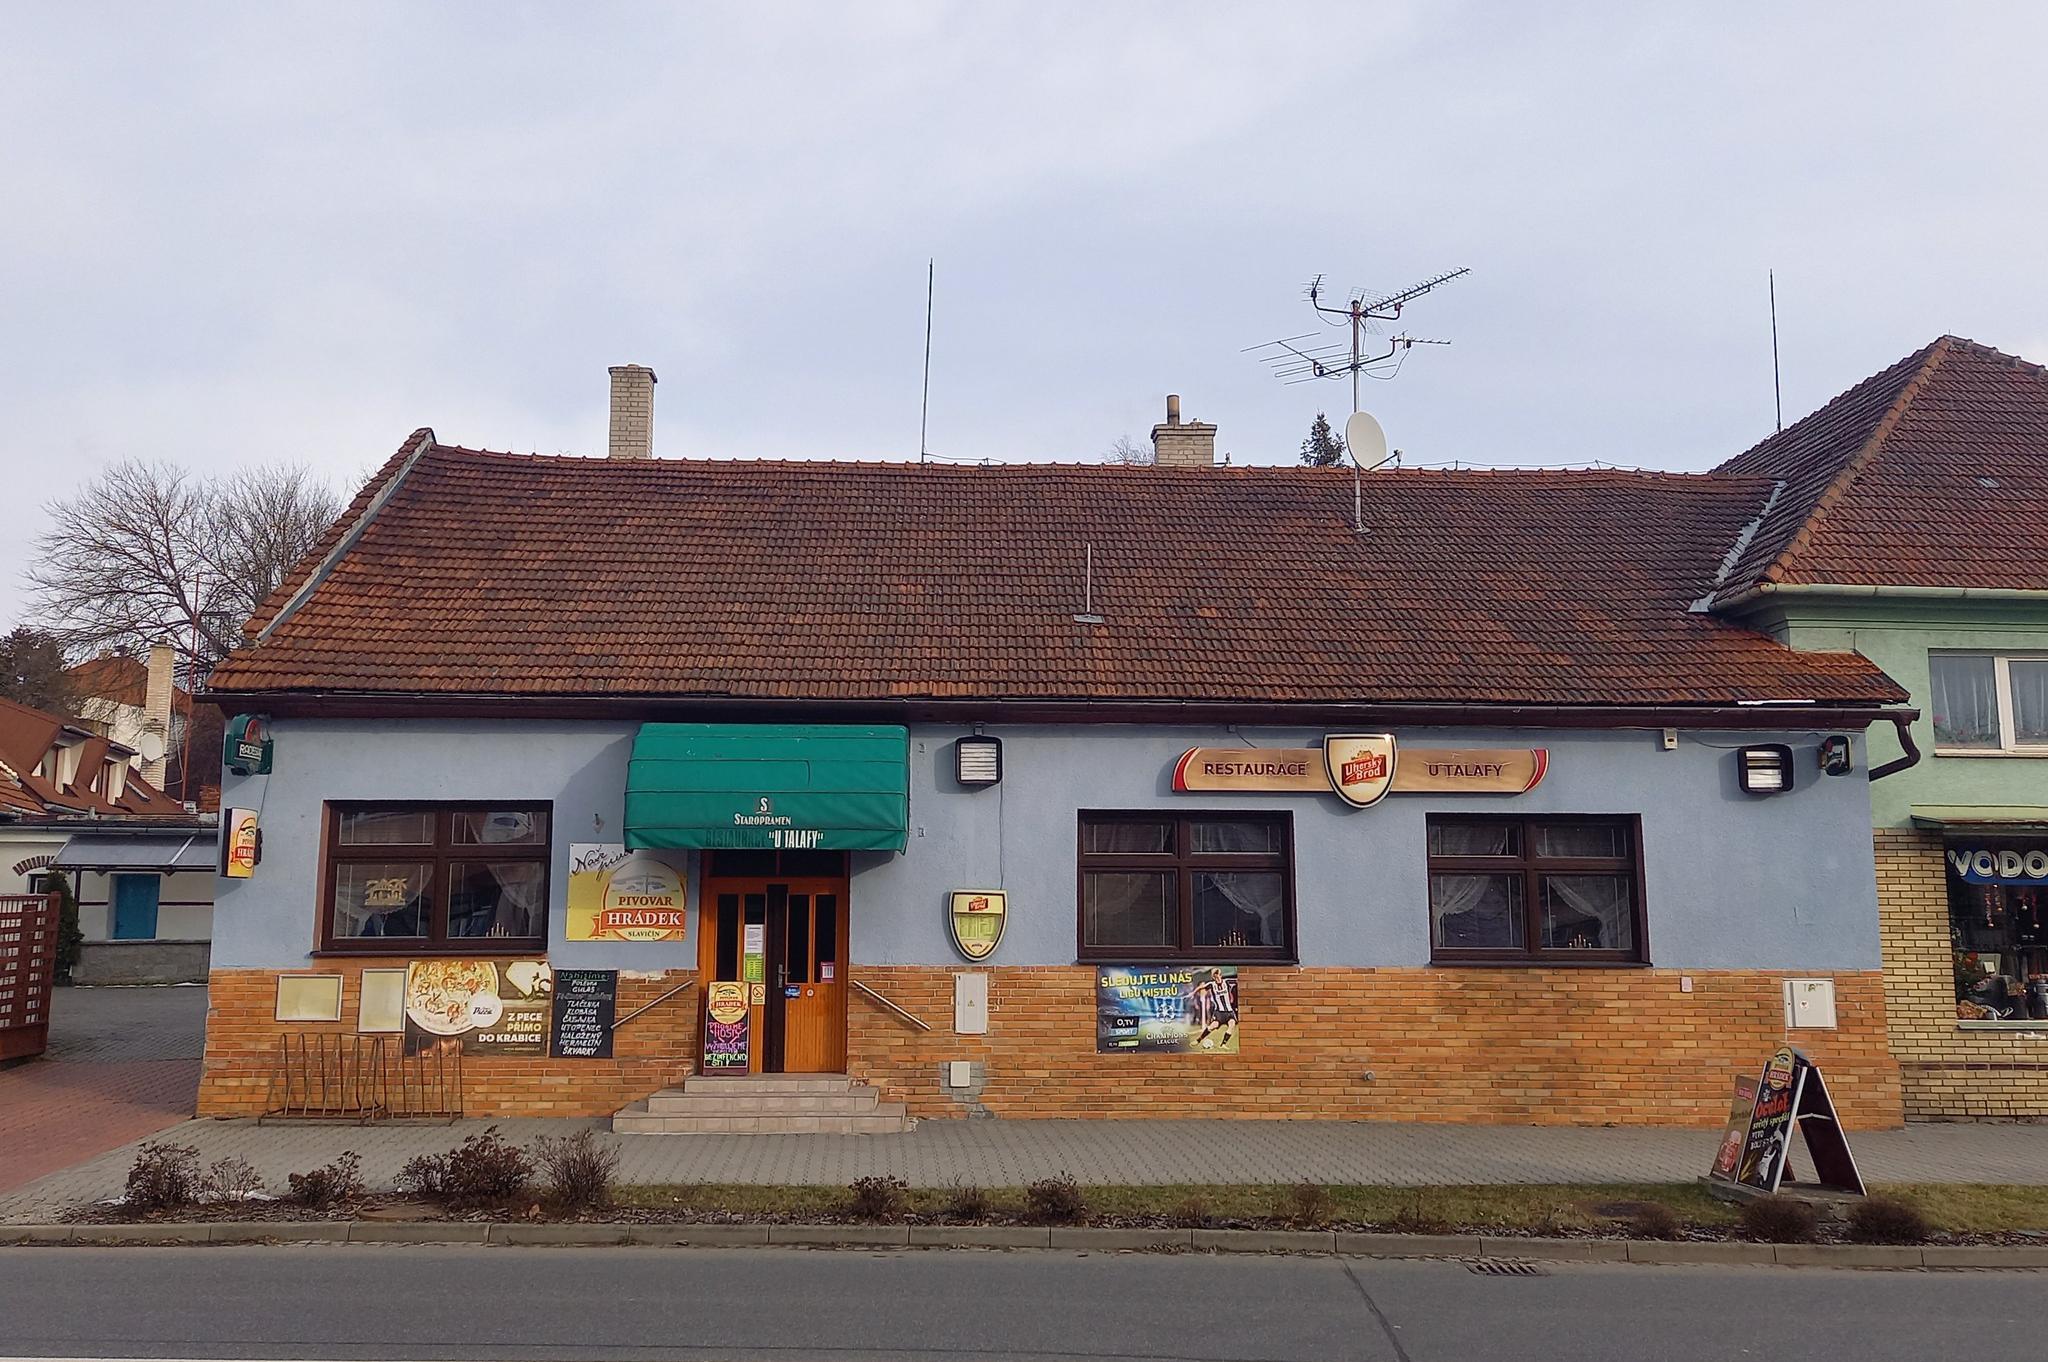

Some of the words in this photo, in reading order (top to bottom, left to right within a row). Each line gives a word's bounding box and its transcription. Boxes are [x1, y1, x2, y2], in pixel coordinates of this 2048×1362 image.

[1204, 763, 1307, 776] RESTAURACE
[1356, 766, 1381, 780] Brod
[1429, 765, 1439, 777] U
[1446, 765, 1503, 777] TALAFY
[618, 896, 673, 906] PIVOVAR
[607, 910, 682, 925] HRÁDEK
[1101, 973, 1157, 987] SLEDUJTE
[1160, 974, 1167, 984] U
[1169, 970, 1193, 984] NÁS
[1119, 986, 1140, 998] LIGU
[507, 1013, 515, 1021] Z
[516, 1012, 543, 1021] PECE
[506, 1022, 542, 1032] PŘÍMO
[479, 1034, 495, 1043] DO
[496, 1034, 541, 1043] KRABICE
